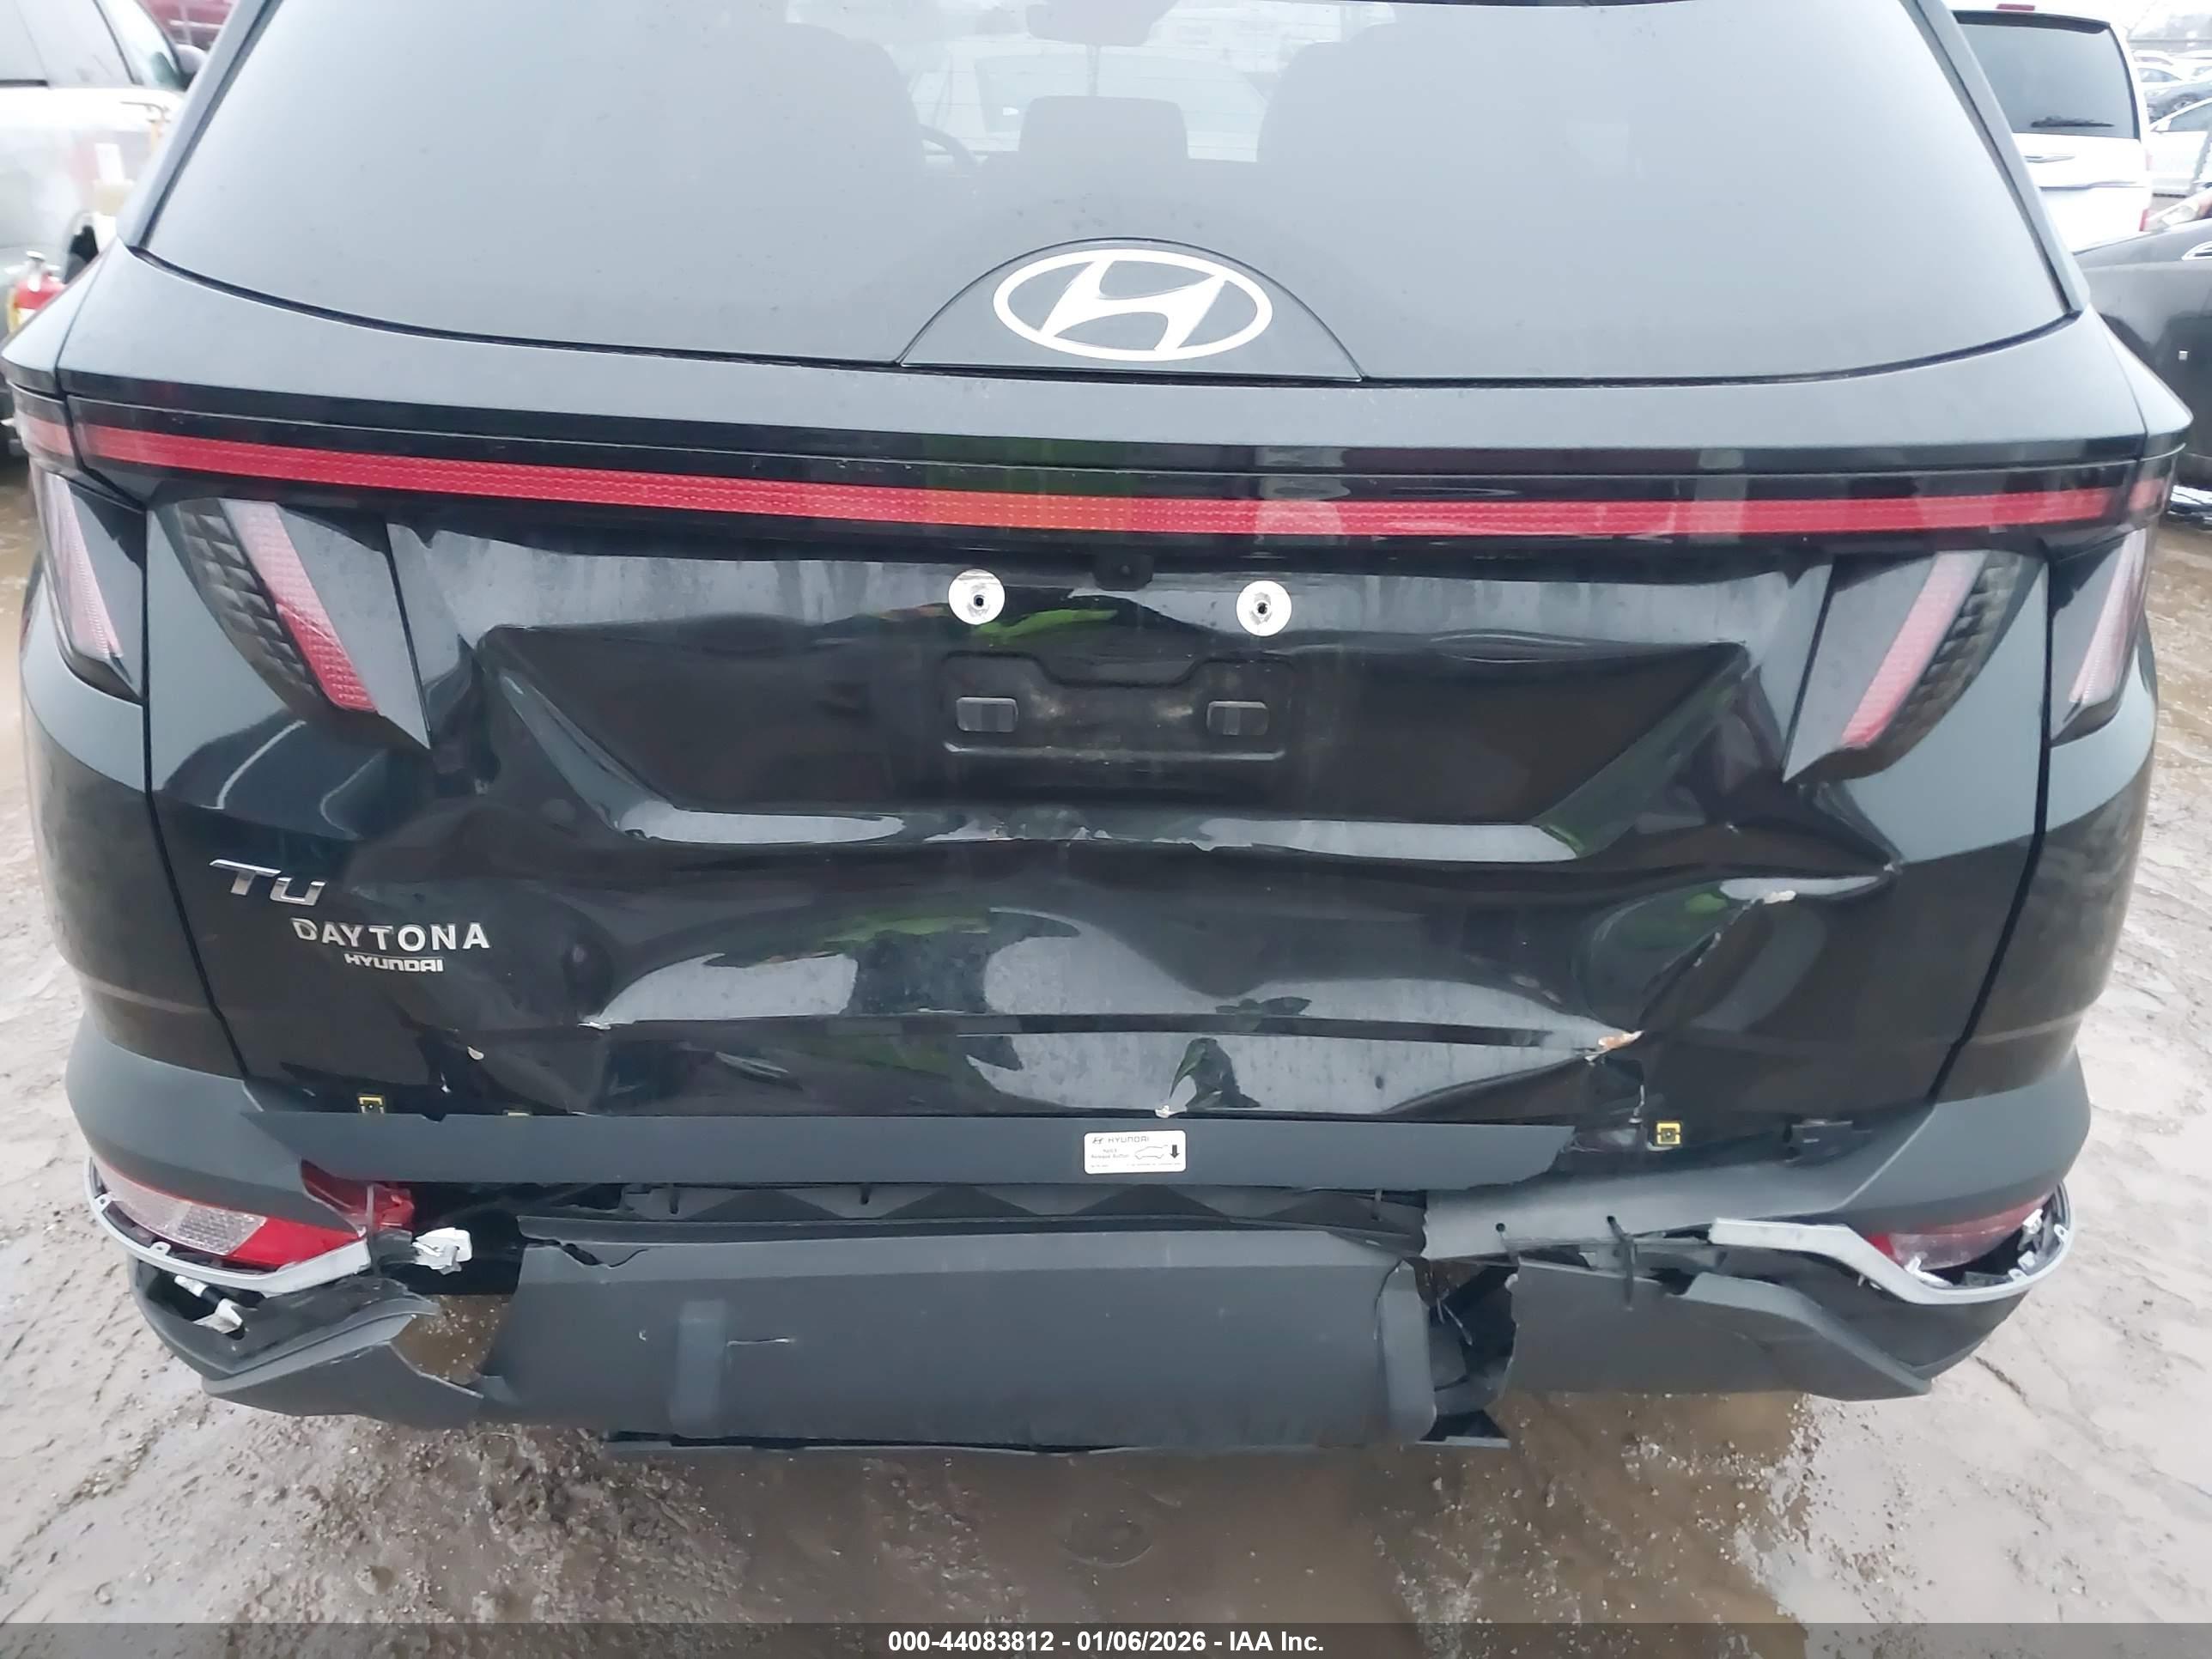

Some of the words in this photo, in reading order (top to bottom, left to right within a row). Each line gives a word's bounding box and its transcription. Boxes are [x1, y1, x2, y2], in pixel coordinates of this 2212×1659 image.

[209, 859, 327, 906] TU
[290, 916, 490, 952] DAYTONA
[344, 952, 445, 973] HYUNDAI
[1108, 1135, 1150, 1144] HYUNDAI
